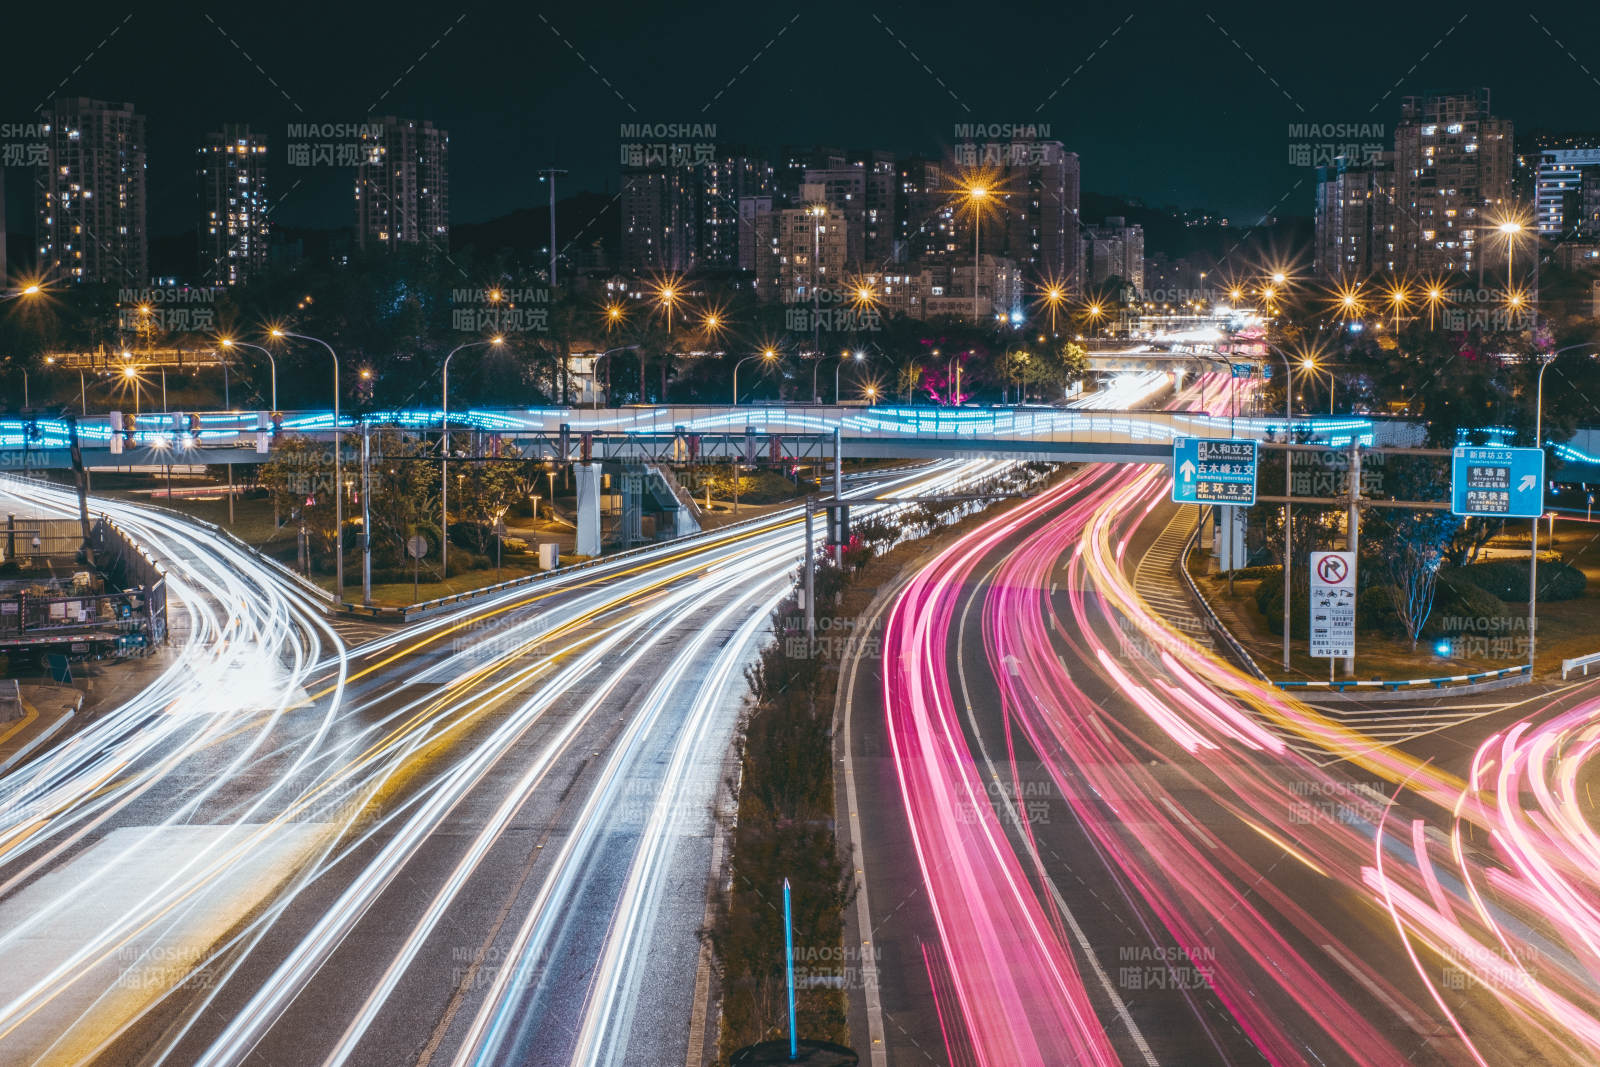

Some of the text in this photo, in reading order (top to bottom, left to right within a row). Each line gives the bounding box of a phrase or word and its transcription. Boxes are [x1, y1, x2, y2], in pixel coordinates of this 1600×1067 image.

[1208, 443, 1253, 455] 人和立交
[1197, 464, 1254, 475] 古木峰立交
[1473, 467, 1506, 477] 机场路
[1197, 482, 1253, 495] 北环立交
[1467, 491, 1509, 501] 内环快速
